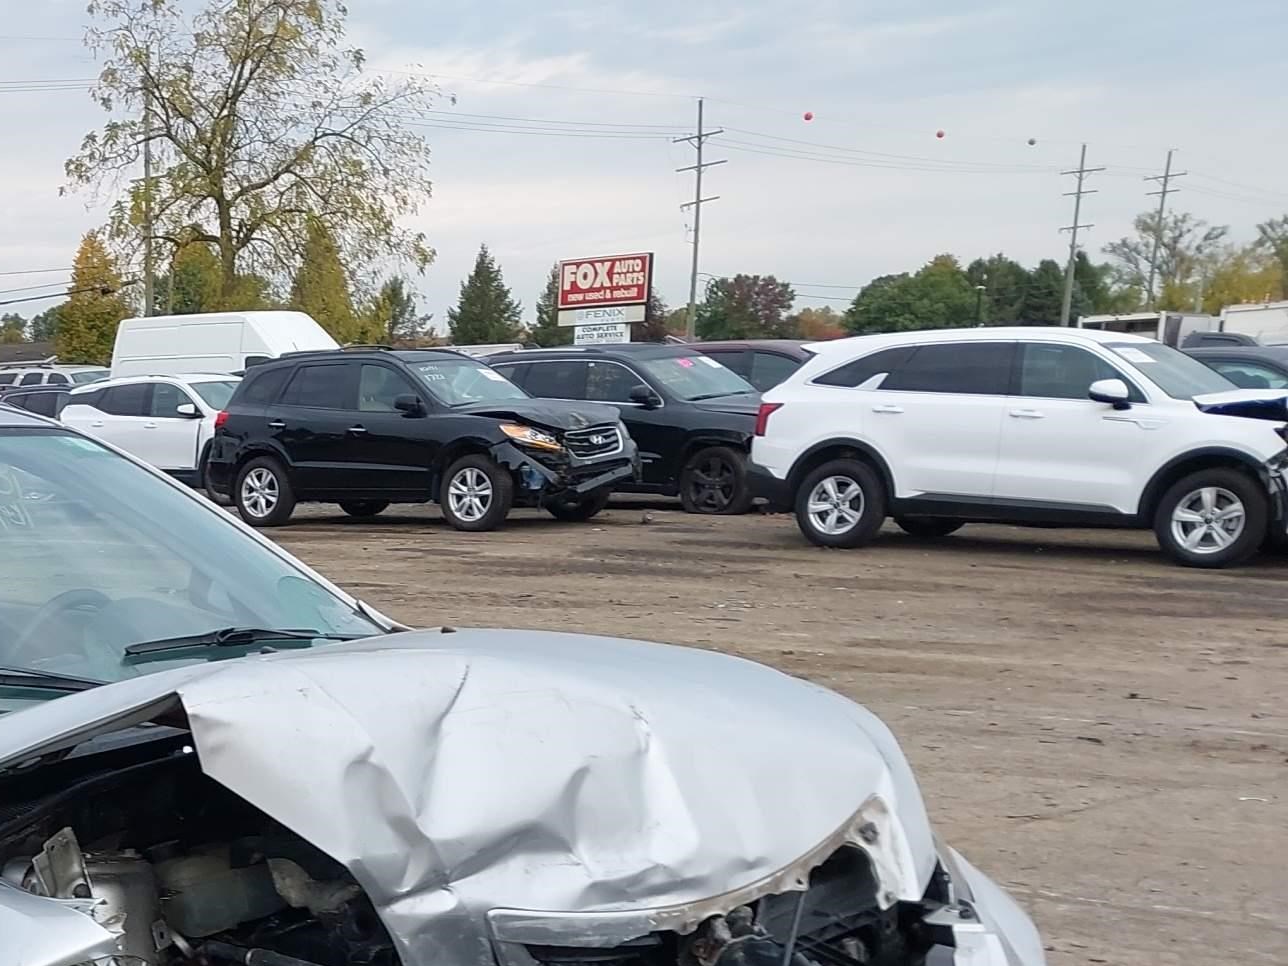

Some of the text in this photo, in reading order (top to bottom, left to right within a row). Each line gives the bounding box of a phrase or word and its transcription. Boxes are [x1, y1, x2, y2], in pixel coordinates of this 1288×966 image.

[613, 259, 642, 272] AUTO
[563, 263, 612, 290] FOX
[613, 272, 644, 286] PARTS
[586, 309, 624, 318] FENIX
